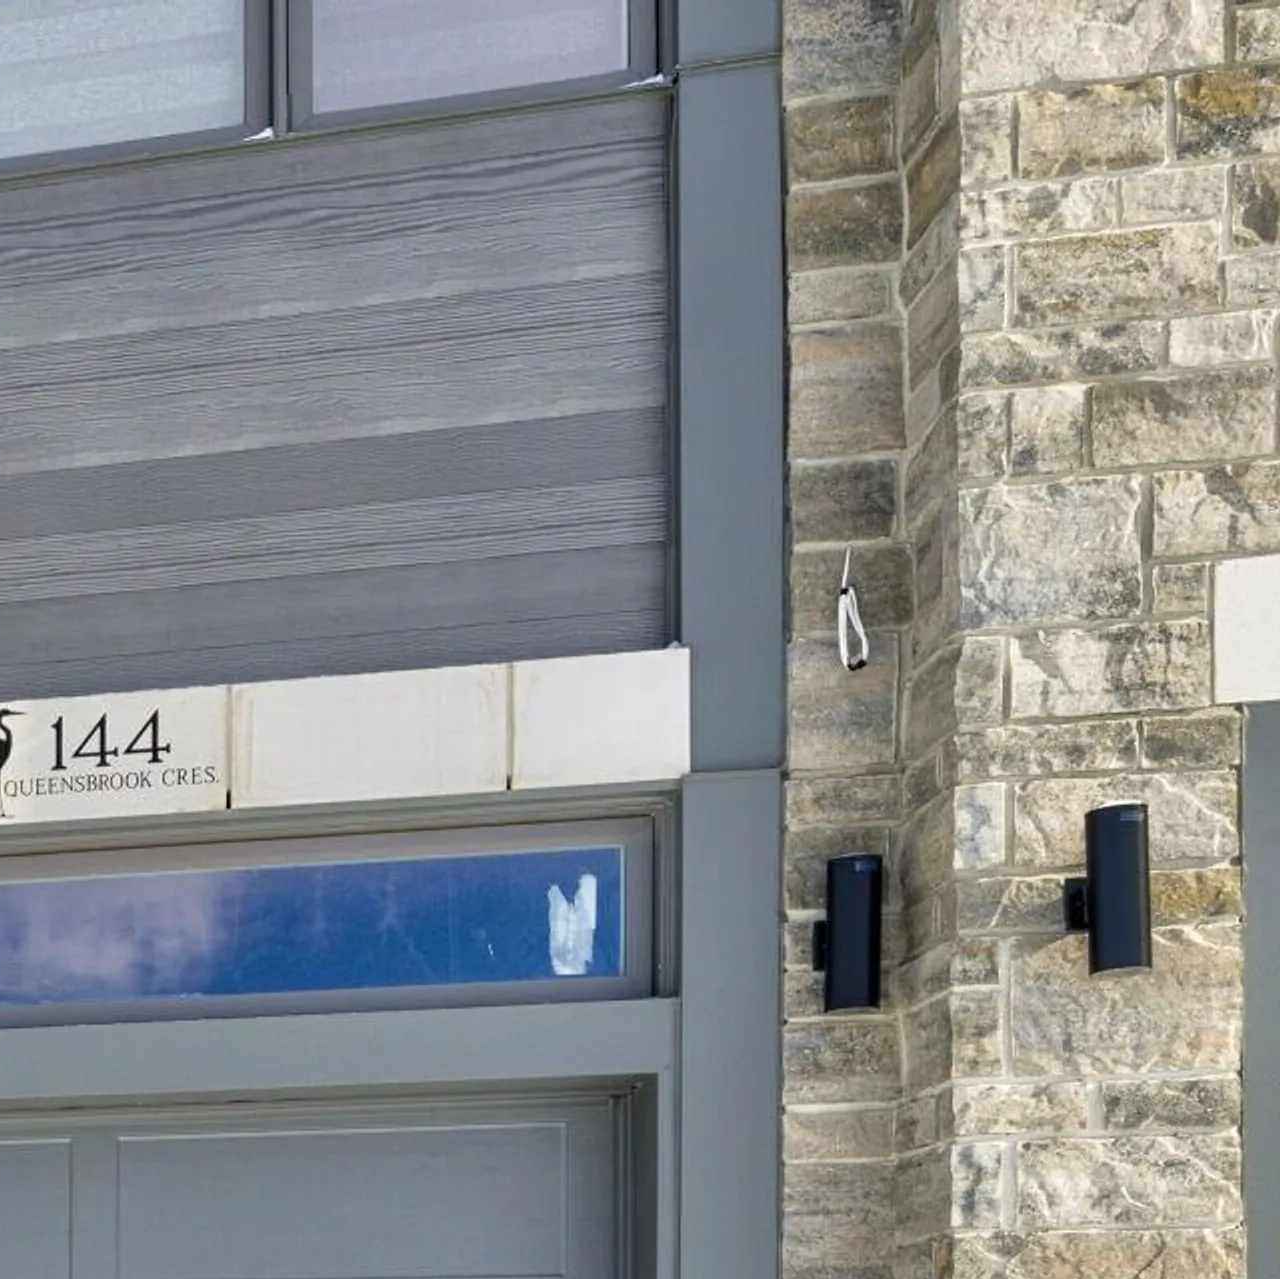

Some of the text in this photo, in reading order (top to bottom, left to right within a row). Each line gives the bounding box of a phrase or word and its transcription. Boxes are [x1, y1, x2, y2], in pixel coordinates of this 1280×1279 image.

[50, 708, 171, 771] 144
[3, 766, 221, 798] QUEENSBROOK CRES.
